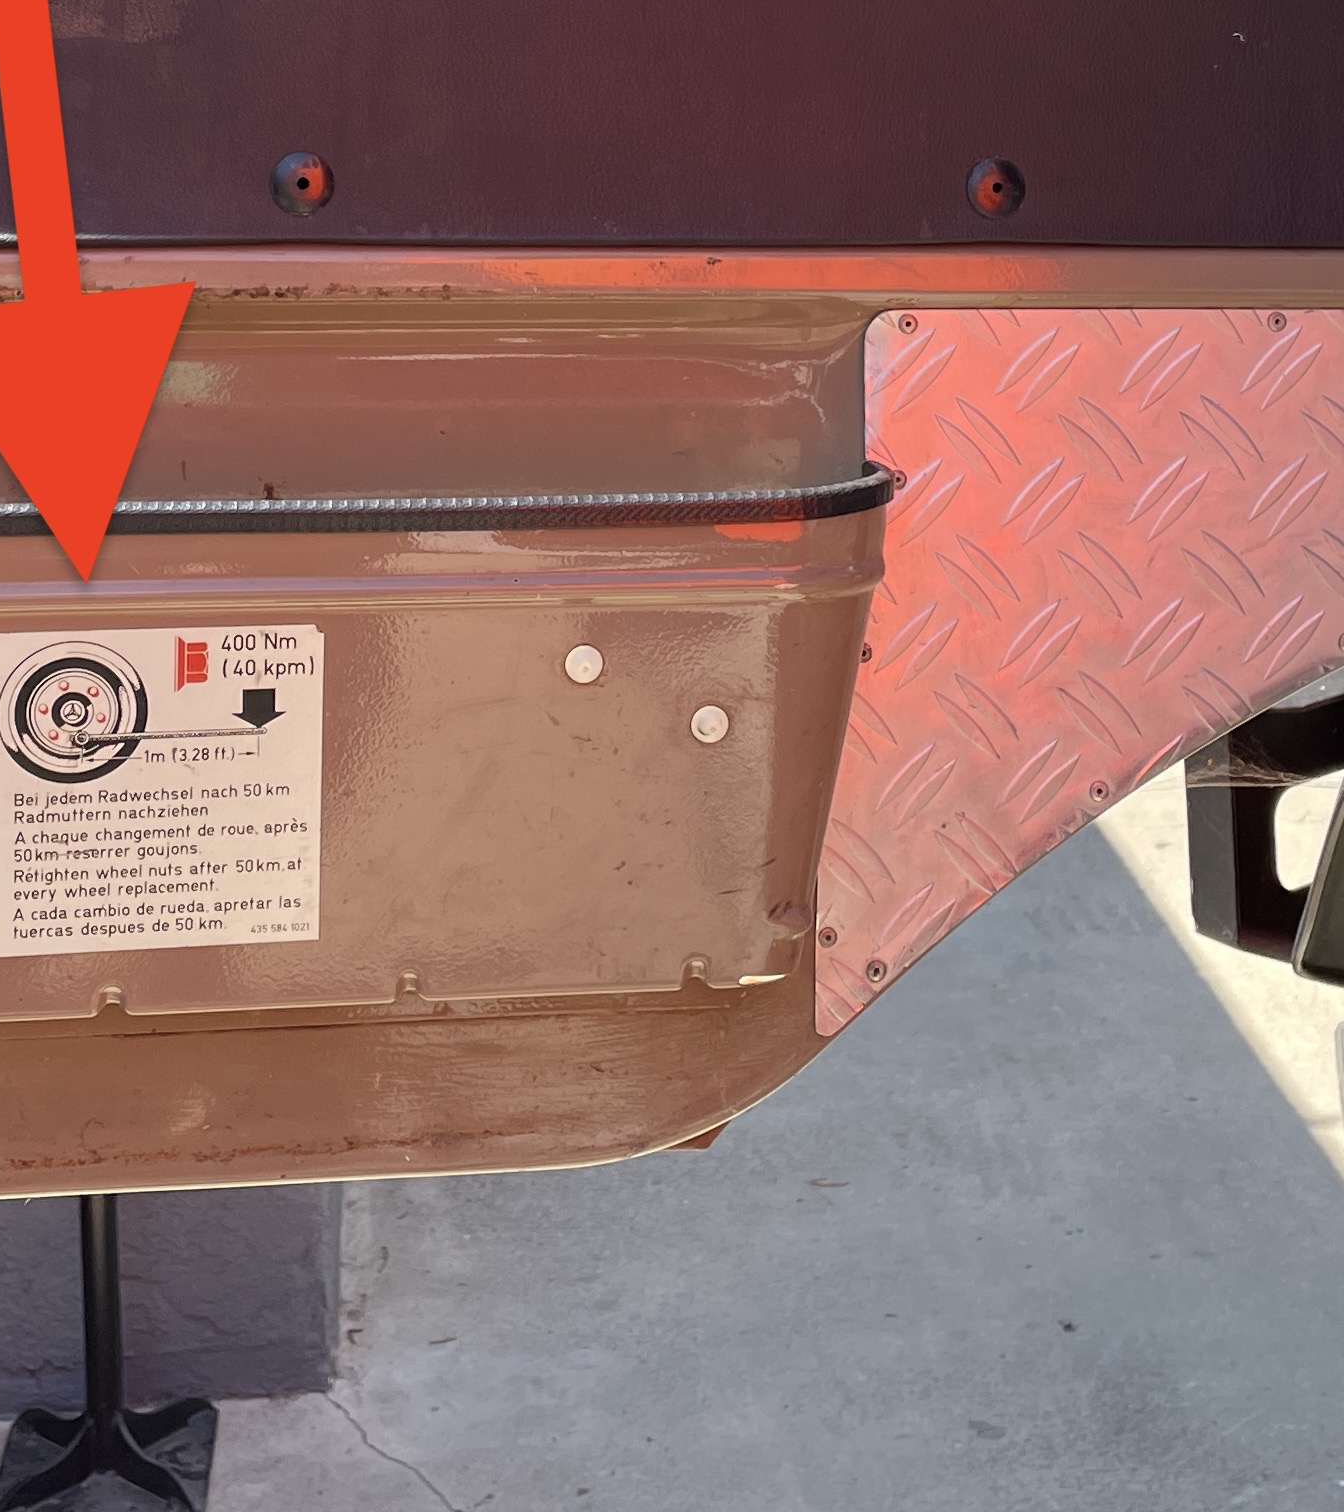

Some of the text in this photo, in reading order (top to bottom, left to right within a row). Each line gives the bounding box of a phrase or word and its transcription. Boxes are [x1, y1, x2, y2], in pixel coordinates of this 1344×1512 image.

[221, 633, 297, 651] 400 Nm
[264, 656, 314, 679] kpm)
[144, 749, 165, 763] 1m
[215, 747, 235, 761] ft.)
[14, 793, 38, 807] Bei
[45, 792, 92, 809] jedem
[99, 787, 193, 803] Radwechsel
[201, 785, 238, 799] nach
[14, 805, 208, 824] Radmuttern nachziehen
[15, 831, 26, 845] A
[32, 831, 88, 846] chaque
[96, 827, 190, 843] changement
[198, 824, 215, 837] de
[264, 818, 308, 837] après
[66, 847, 130, 860] reserrer
[137, 843, 202, 860] goujons.
[96, 864, 142, 880] wheel
[149, 863, 182, 877] nuts
[190, 862, 228, 874] after
[14, 878, 219, 902] every wheel replacement.
[13, 908, 24, 922] A
[31, 906, 67, 921] cada
[74, 903, 130, 918] cambio
[137, 902, 154, 915] de
[214, 898, 272, 915] apretar
[279, 896, 302, 908] las
[14, 926, 73, 939] tuercas
[81, 922, 145, 938] despues
[152, 919, 169, 932] de
[175, 918, 193, 931] 50
[251, 924, 268, 933] 435
[271, 924, 287, 933] 584
